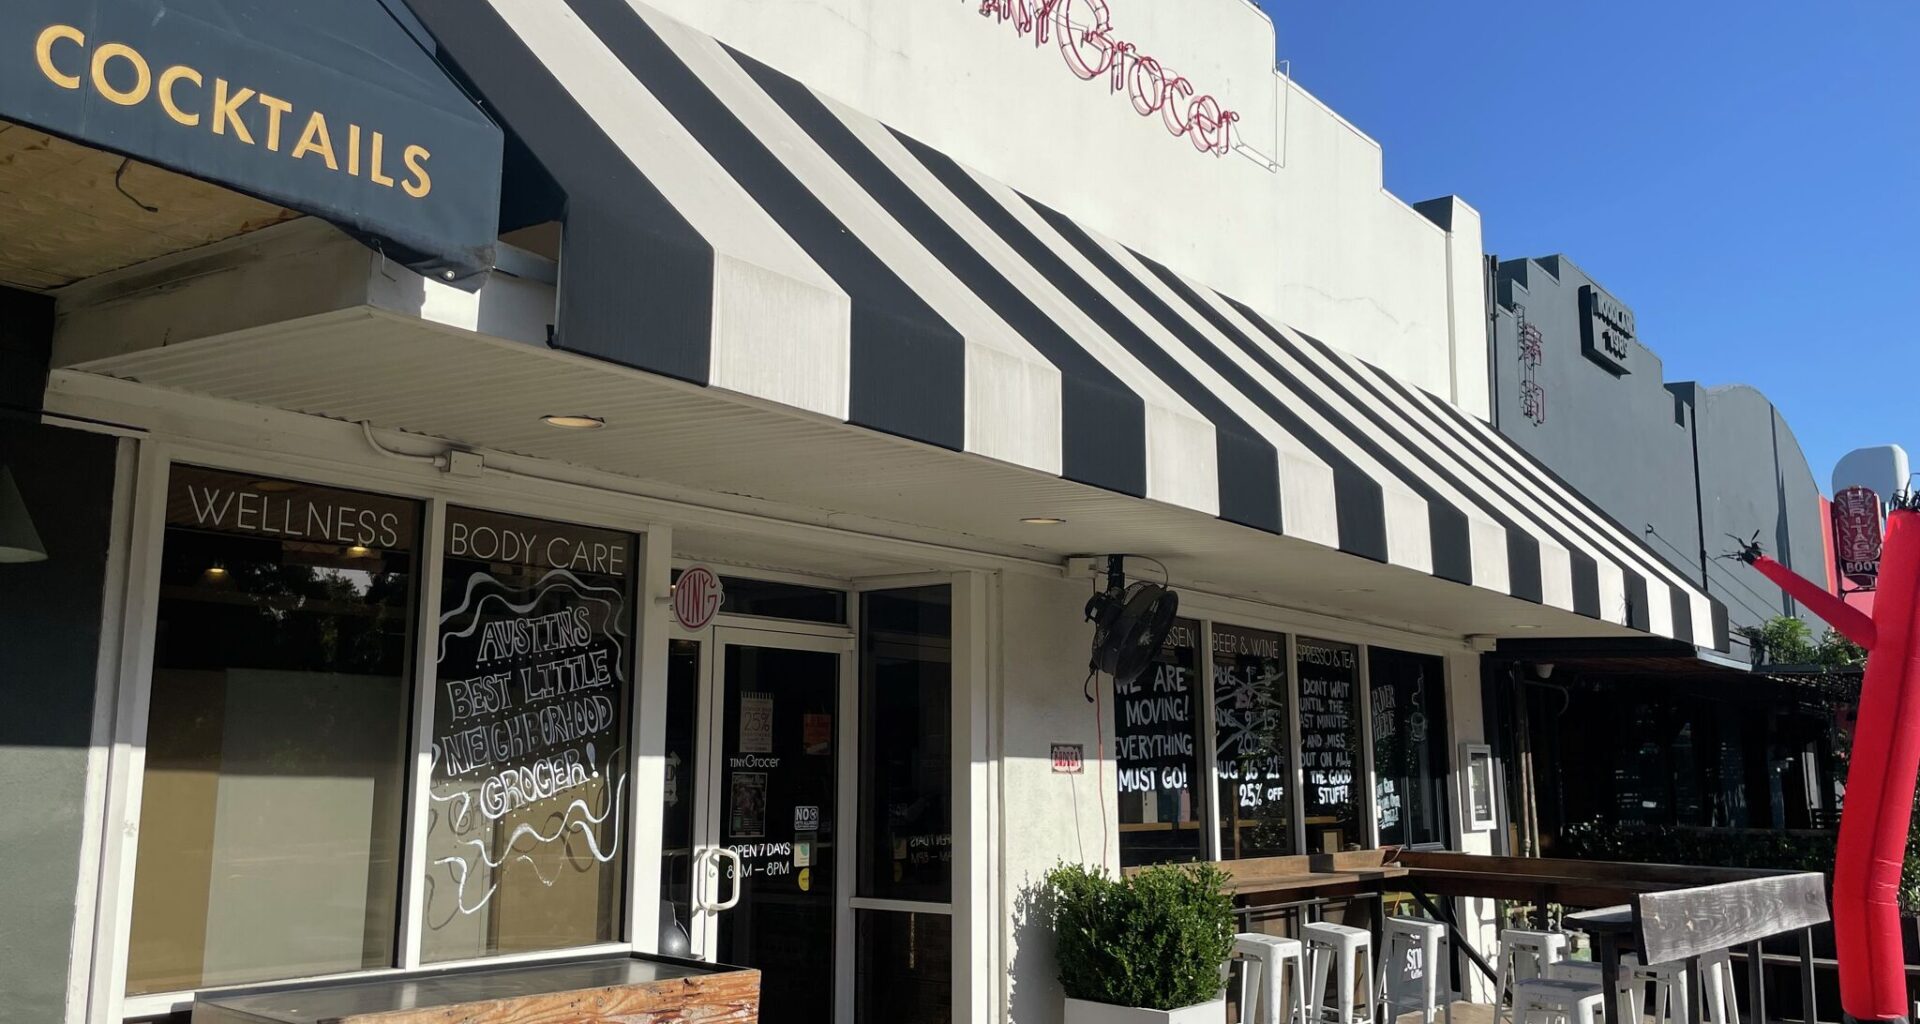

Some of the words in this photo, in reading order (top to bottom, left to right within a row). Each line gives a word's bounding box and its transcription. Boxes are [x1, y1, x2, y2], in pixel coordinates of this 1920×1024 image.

[34, 24, 432, 198] COCKTAILS
[188, 484, 399, 548] WELLNESS
[451, 522, 537, 563] BODY
[546, 537, 624, 577] CARE
[477, 606, 592, 662] AUSTIN'S
[1212, 632, 1237, 653] BEER
[1240, 635, 1249, 656] &
[1250, 637, 1279, 659] WINE
[1296, 643, 1332, 666] SPRESSO
[1341, 650, 1357, 670] TEA
[446, 671, 513, 722] BEST
[520, 649, 611, 704] LITTLE
[1153, 664, 1187, 692] ARE
[1329, 680, 1350, 698] WAIT
[744, 711, 770, 732] 25%
[1125, 694, 1190, 727] MOVING!
[1300, 713, 1314, 729] AST
[441, 695, 613, 776] NEIGHBORHOOD
[1114, 731, 1193, 760] EVERYTHING
[1306, 734, 1323, 749] AND
[1319, 751, 1332, 768] ON
[479, 742, 599, 820] GROCER!
[1118, 766, 1158, 793] MUST
[1161, 762, 1188, 791] GO!
[1310, 769, 1328, 785] THE
[1328, 769, 1352, 786] GOOD
[1239, 782, 1263, 807] 25%
[1267, 786, 1284, 801] OFF
[1317, 785, 1349, 805] STUFF!
[796, 808, 809, 821] NO
[728, 844, 757, 858] OPEN
[759, 843, 765, 857] 7
[766, 842, 791, 856] DAYS
[766, 861, 790, 876] 8PM
